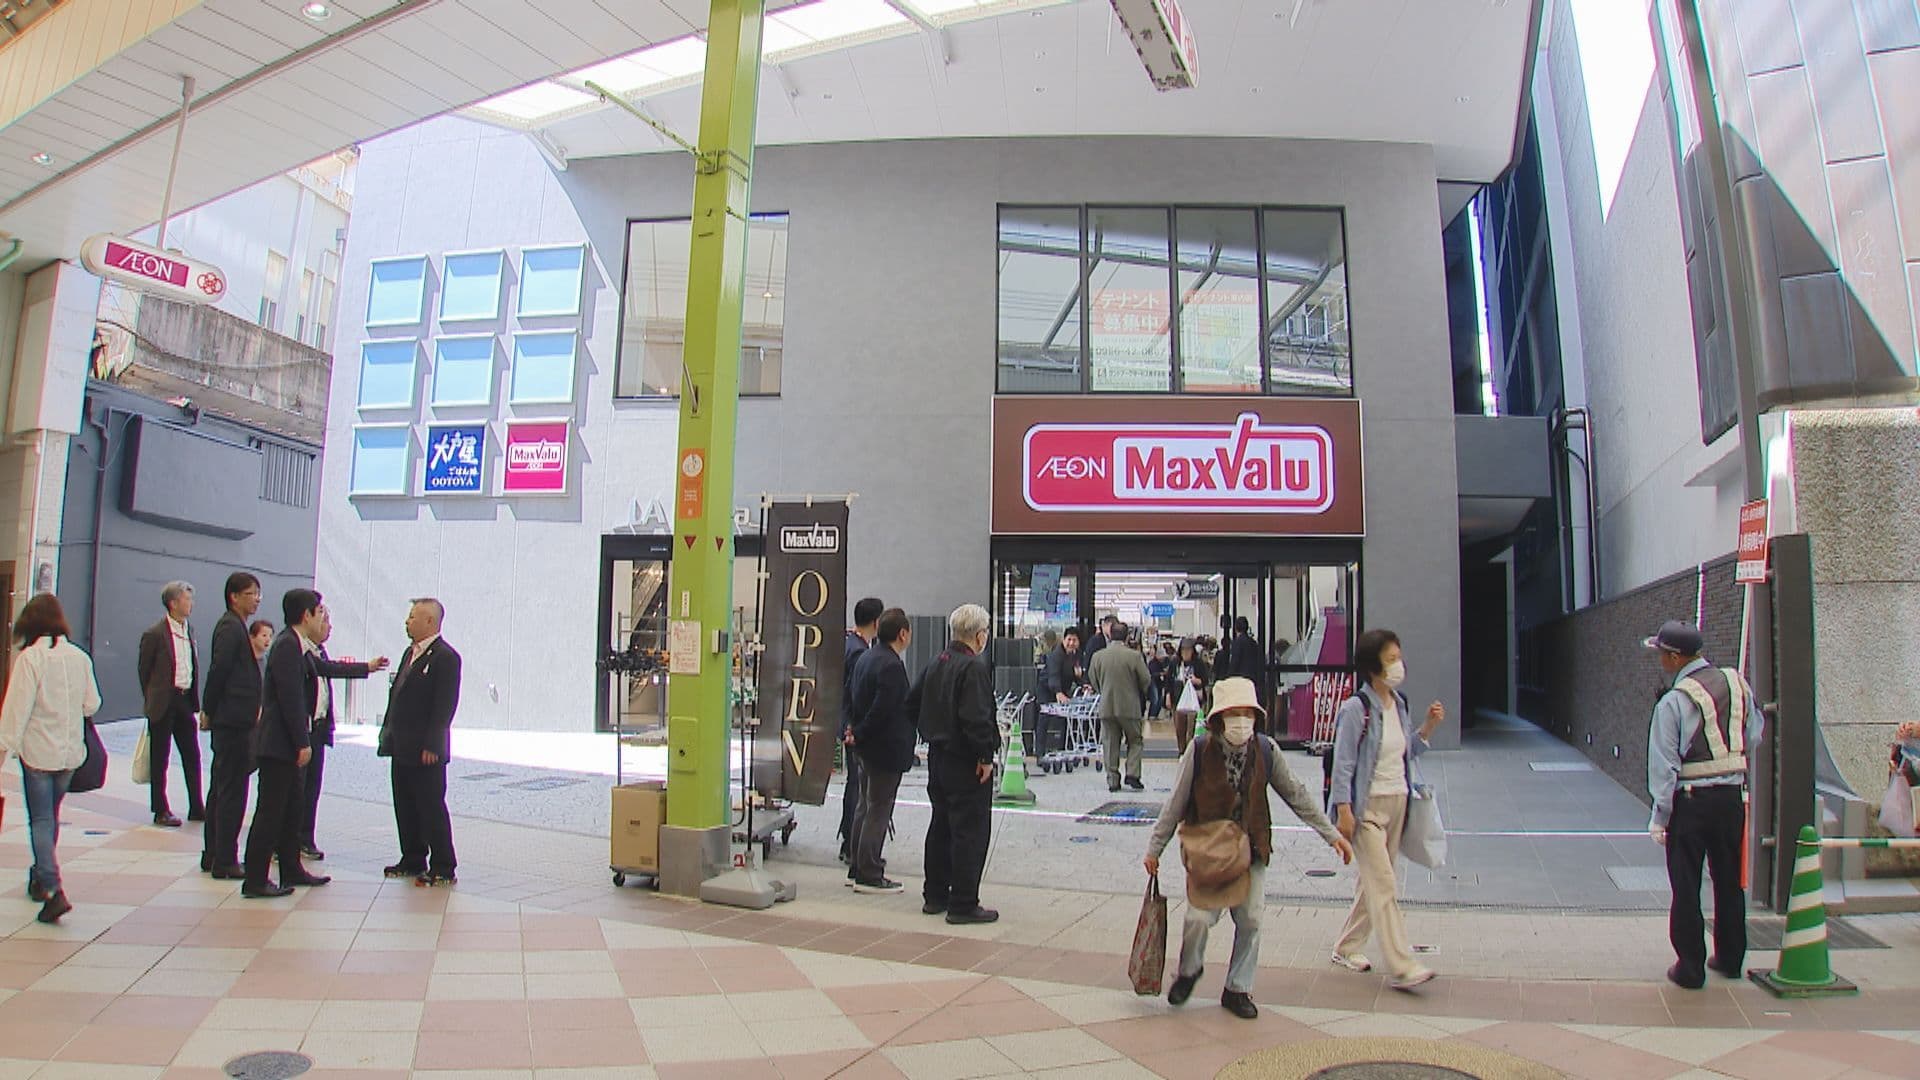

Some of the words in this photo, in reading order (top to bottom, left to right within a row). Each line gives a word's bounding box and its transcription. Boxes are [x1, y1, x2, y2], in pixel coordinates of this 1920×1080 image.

[1101, 292, 1160, 310] テナント
[430, 430, 479, 470] 大戸屋
[514, 442, 558, 461] MaxValu
[1124, 418, 1311, 492] MaxValu
[431, 477, 475, 487] OOTOYA
[785, 522, 835, 549] MaxValu
[781, 569, 829, 777] OPEN
